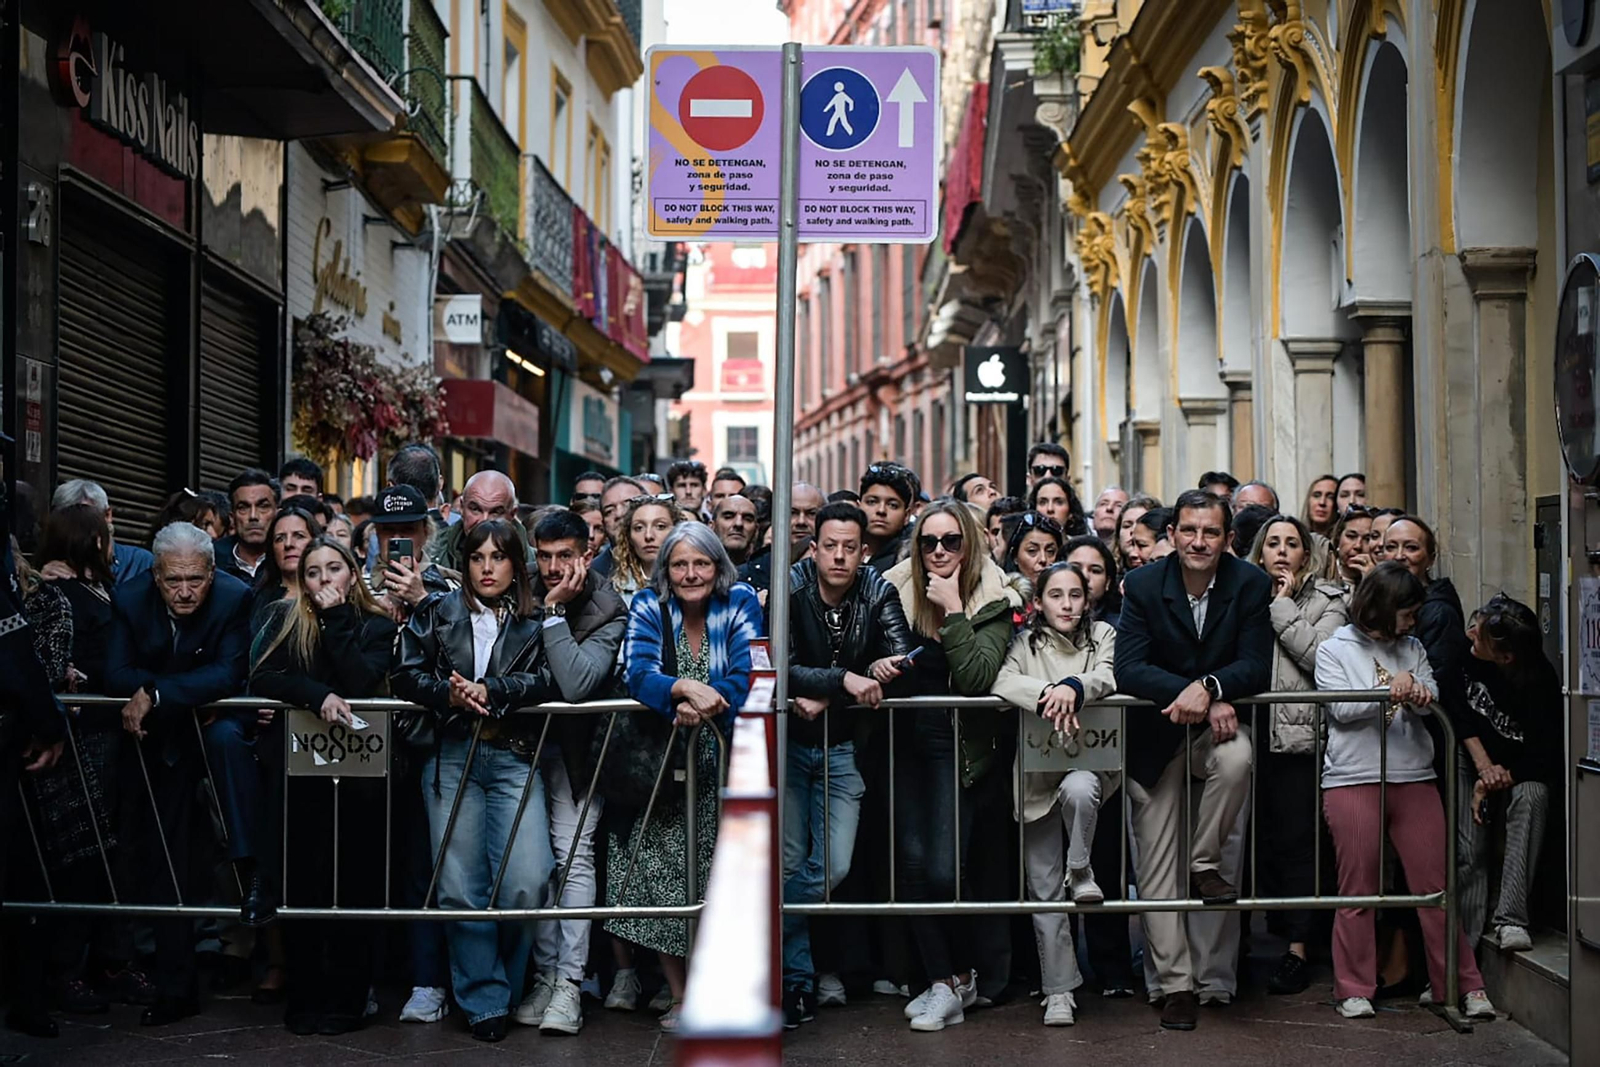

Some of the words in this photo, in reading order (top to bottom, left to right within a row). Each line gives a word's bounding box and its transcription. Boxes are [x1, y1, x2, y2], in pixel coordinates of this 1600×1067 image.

[101, 31, 149, 148] Kiss
[152, 71, 199, 181] Nails
[674, 158, 690, 167] NO
[692, 158, 706, 167] SE
[708, 158, 766, 168] DETENGAN,
[815, 159, 830, 168] NO
[832, 159, 846, 168] SE
[848, 159, 907, 169] DETENGAN,
[687, 171, 711, 179] zona
[713, 170, 726, 179] de
[728, 171, 753, 180] paso
[827, 172, 851, 180] zona
[853, 171, 867, 180] de
[869, 172, 894, 181] paso
[689, 184, 695, 192] y
[697, 183, 751, 192] seguridad.
[829, 185, 835, 193] y
[838, 184, 891, 193] seguridad.
[664, 204, 677, 212] DO
[679, 204, 698, 212] NOT
[699, 204, 730, 212] BLOCK
[731, 204, 752, 212] THIS
[754, 204, 775, 213] WAY,
[804, 205, 817, 213] DO
[819, 205, 838, 213] NOT
[840, 205, 870, 213] BLOCK
[872, 205, 893, 213] THIS
[895, 205, 916, 215] WAY,
[666, 216, 693, 226] safety
[695, 216, 712, 224] and
[714, 216, 748, 226] walking
[750, 216, 773, 226] path.
[806, 217, 834, 227] safety
[835, 217, 852, 225] and
[854, 217, 889, 227] walking
[890, 217, 914, 227] path.
[446, 308, 478, 326] ATM
[360, 753, 370, 763] M
